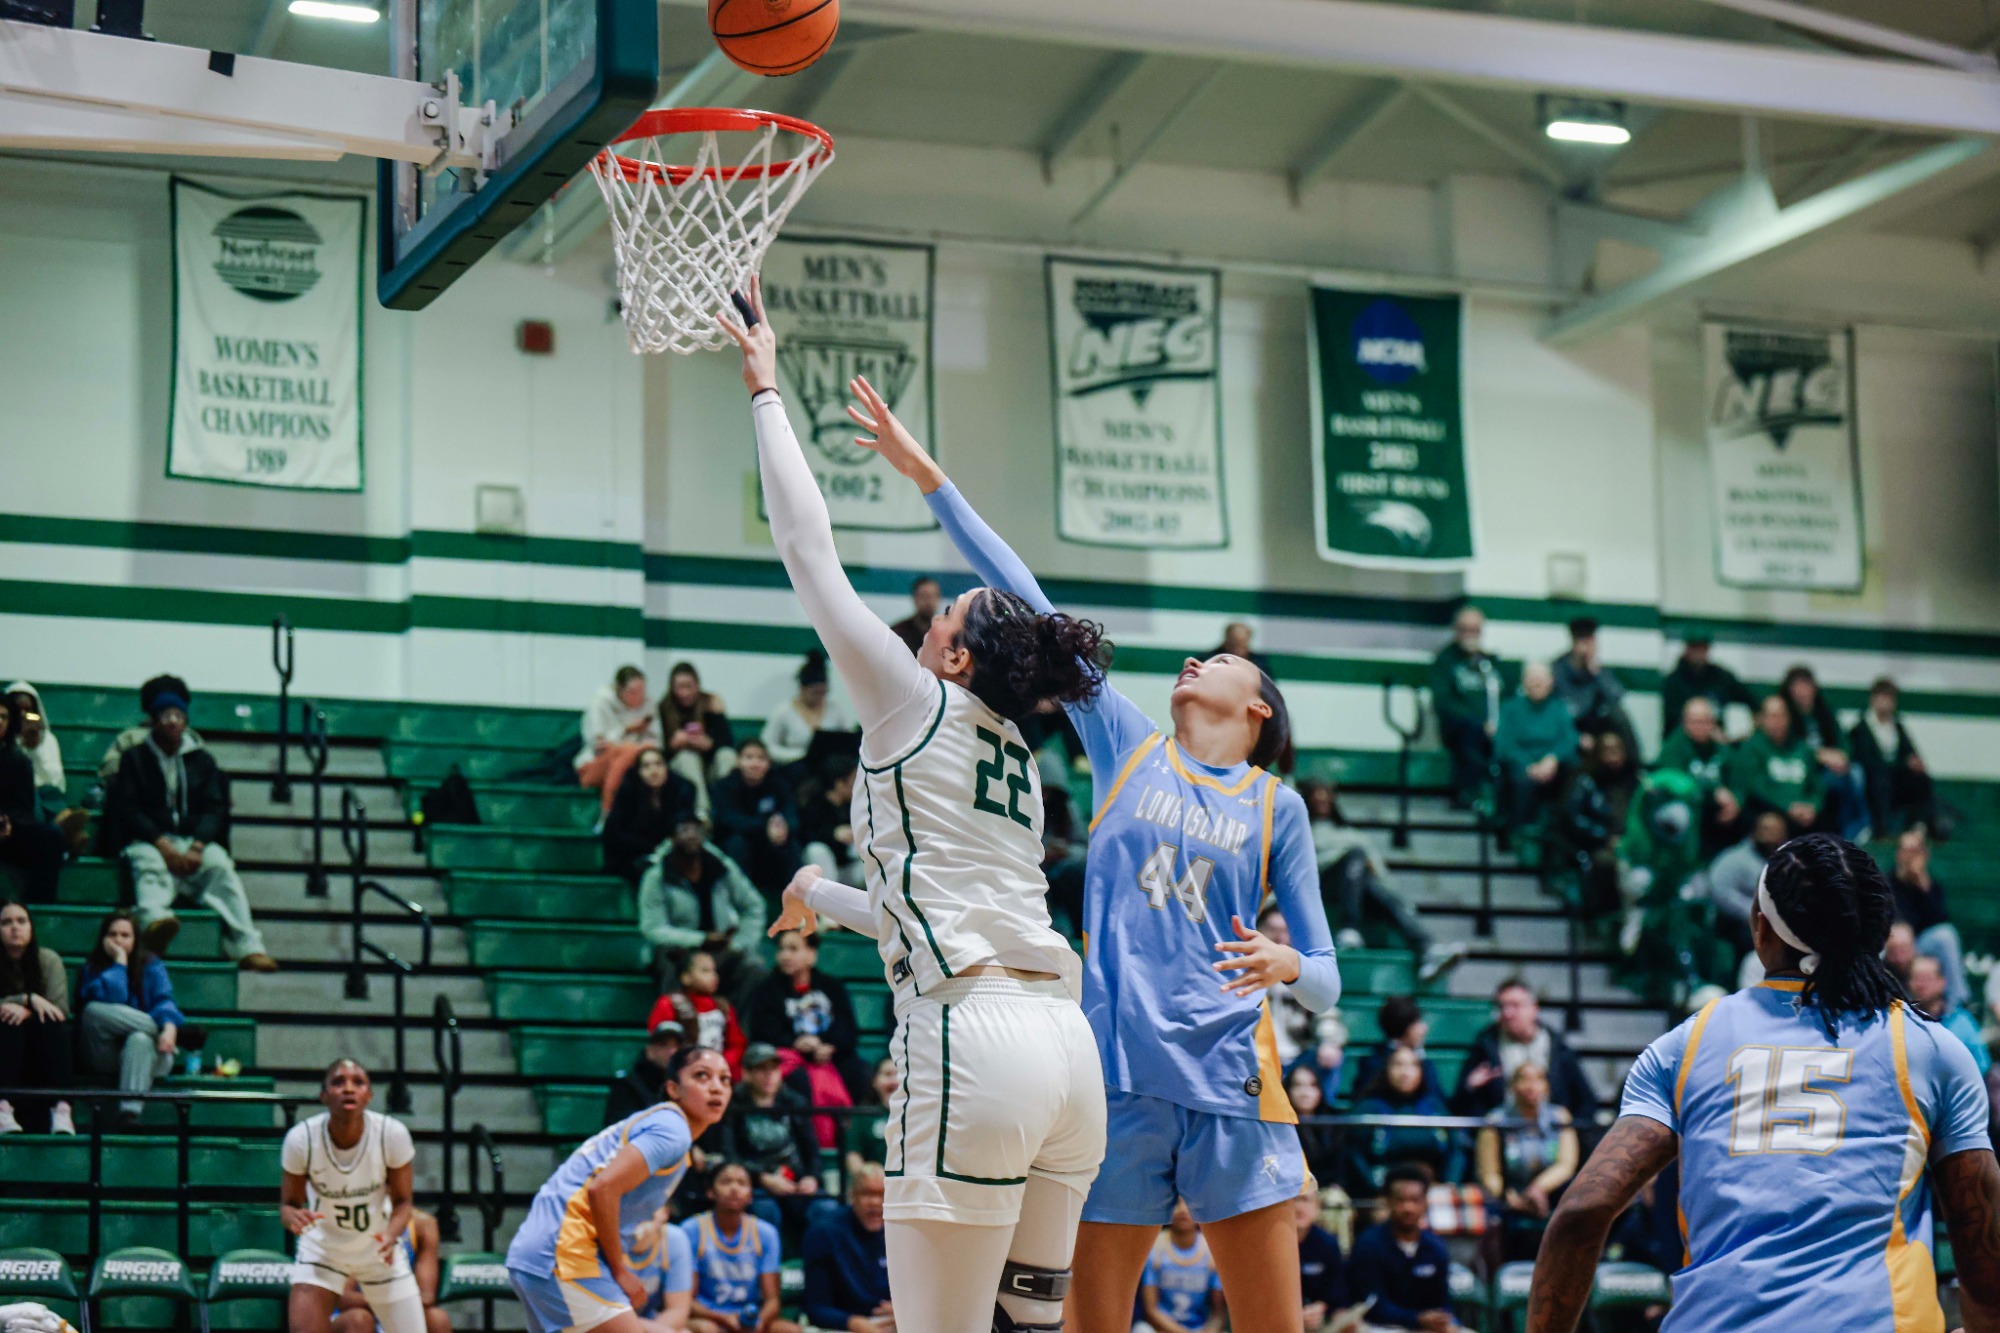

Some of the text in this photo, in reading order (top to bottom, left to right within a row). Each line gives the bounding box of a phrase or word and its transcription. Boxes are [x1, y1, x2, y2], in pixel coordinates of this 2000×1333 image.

[803, 254, 887, 287] MEN'S
[214, 336, 319, 369] WOMEN'S
[199, 369, 334, 407] BASKETBALL
[201, 406, 332, 442] CHAMPIONS
[1065, 447, 1209, 475] BASKETBALL
[973, 724, 1034, 832] 22
[1133, 784, 1249, 856] LONG ISLAND
[1137, 841, 1216, 924] 44
[1725, 1044, 1855, 1157] 15
[333, 1203, 371, 1233] 20
[0, 1259, 63, 1275] AGNER
[103, 1259, 182, 1276] WAGNER
